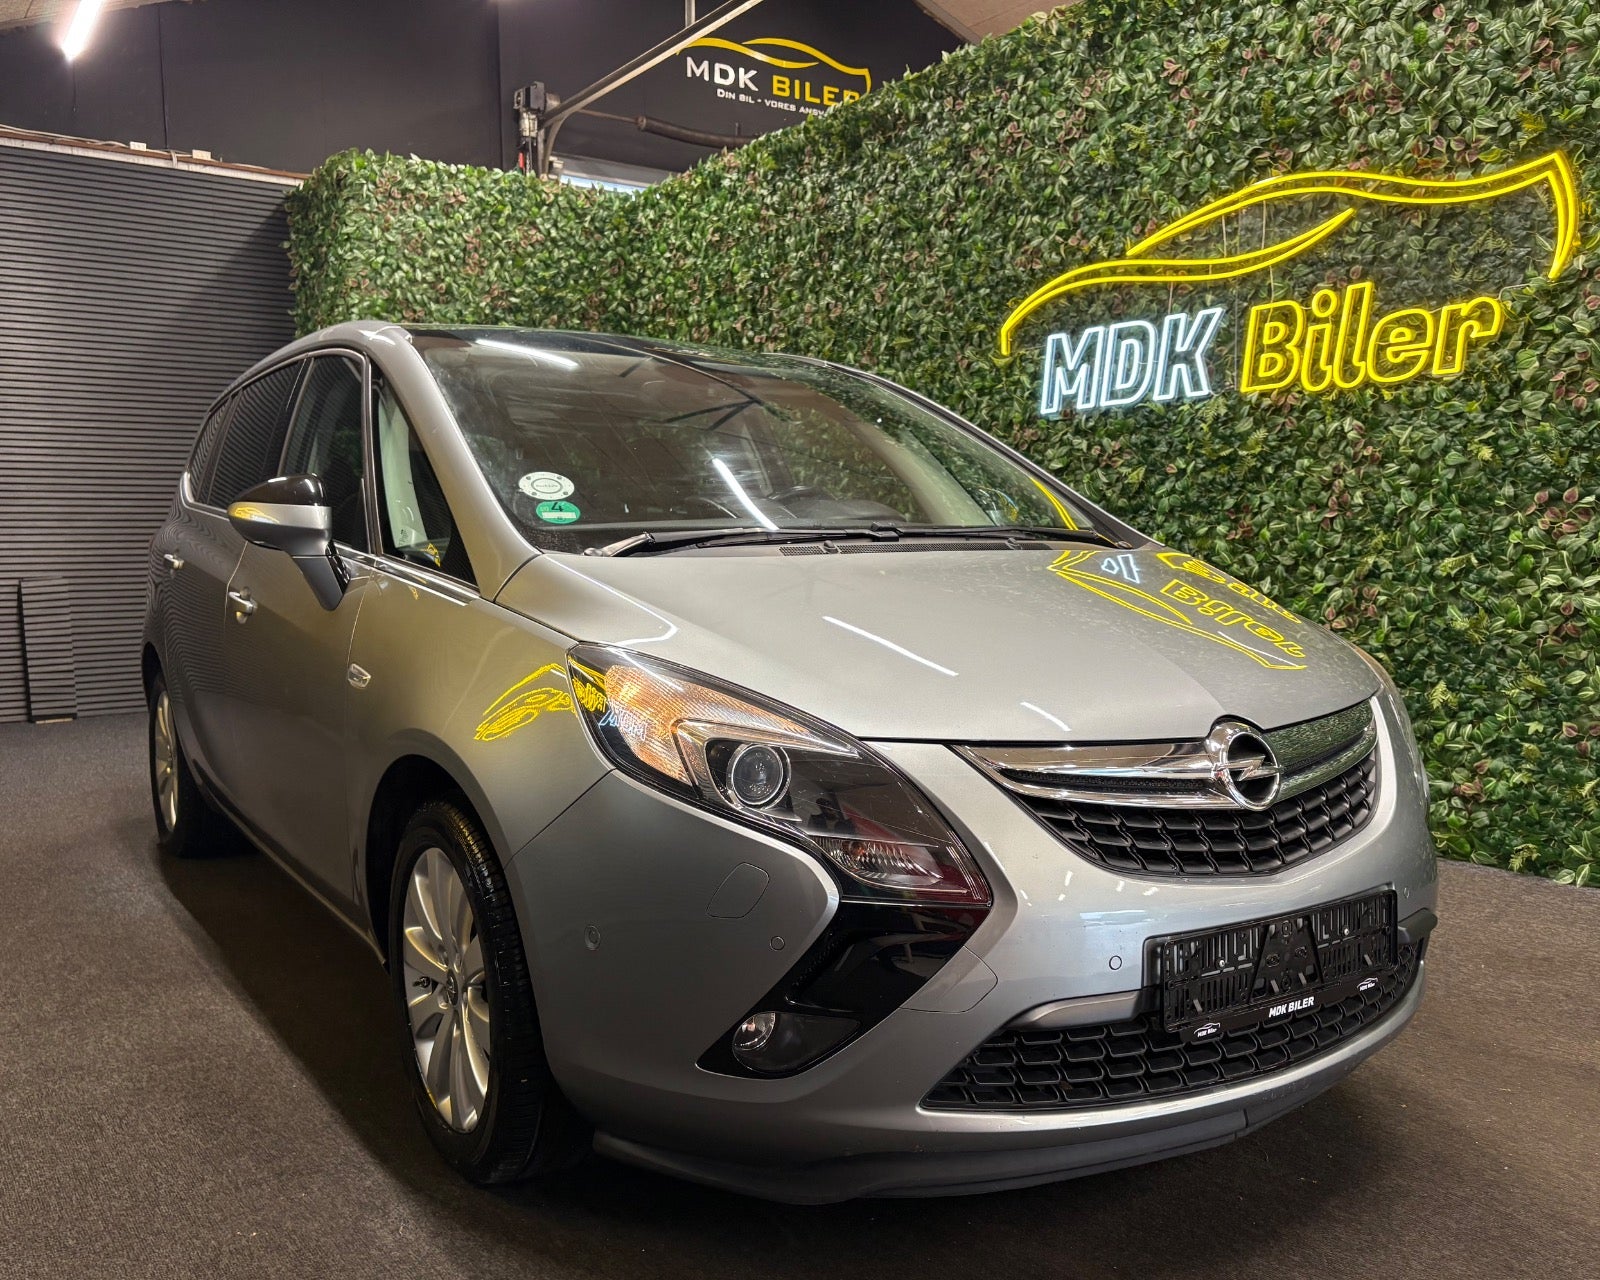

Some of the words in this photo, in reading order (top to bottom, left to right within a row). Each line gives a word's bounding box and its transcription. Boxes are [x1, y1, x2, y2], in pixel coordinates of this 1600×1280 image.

[686, 56, 759, 92] MDK
[716, 88, 736, 100] DIN
[739, 93, 755, 104] BIL
[764, 99, 797, 112] VORES
[1040, 307, 1224, 415] MDK
[1240, 281, 1503, 394] Biler
[1268, 1003, 1288, 1018] MDK
[1288, 996, 1315, 1013] BILER
